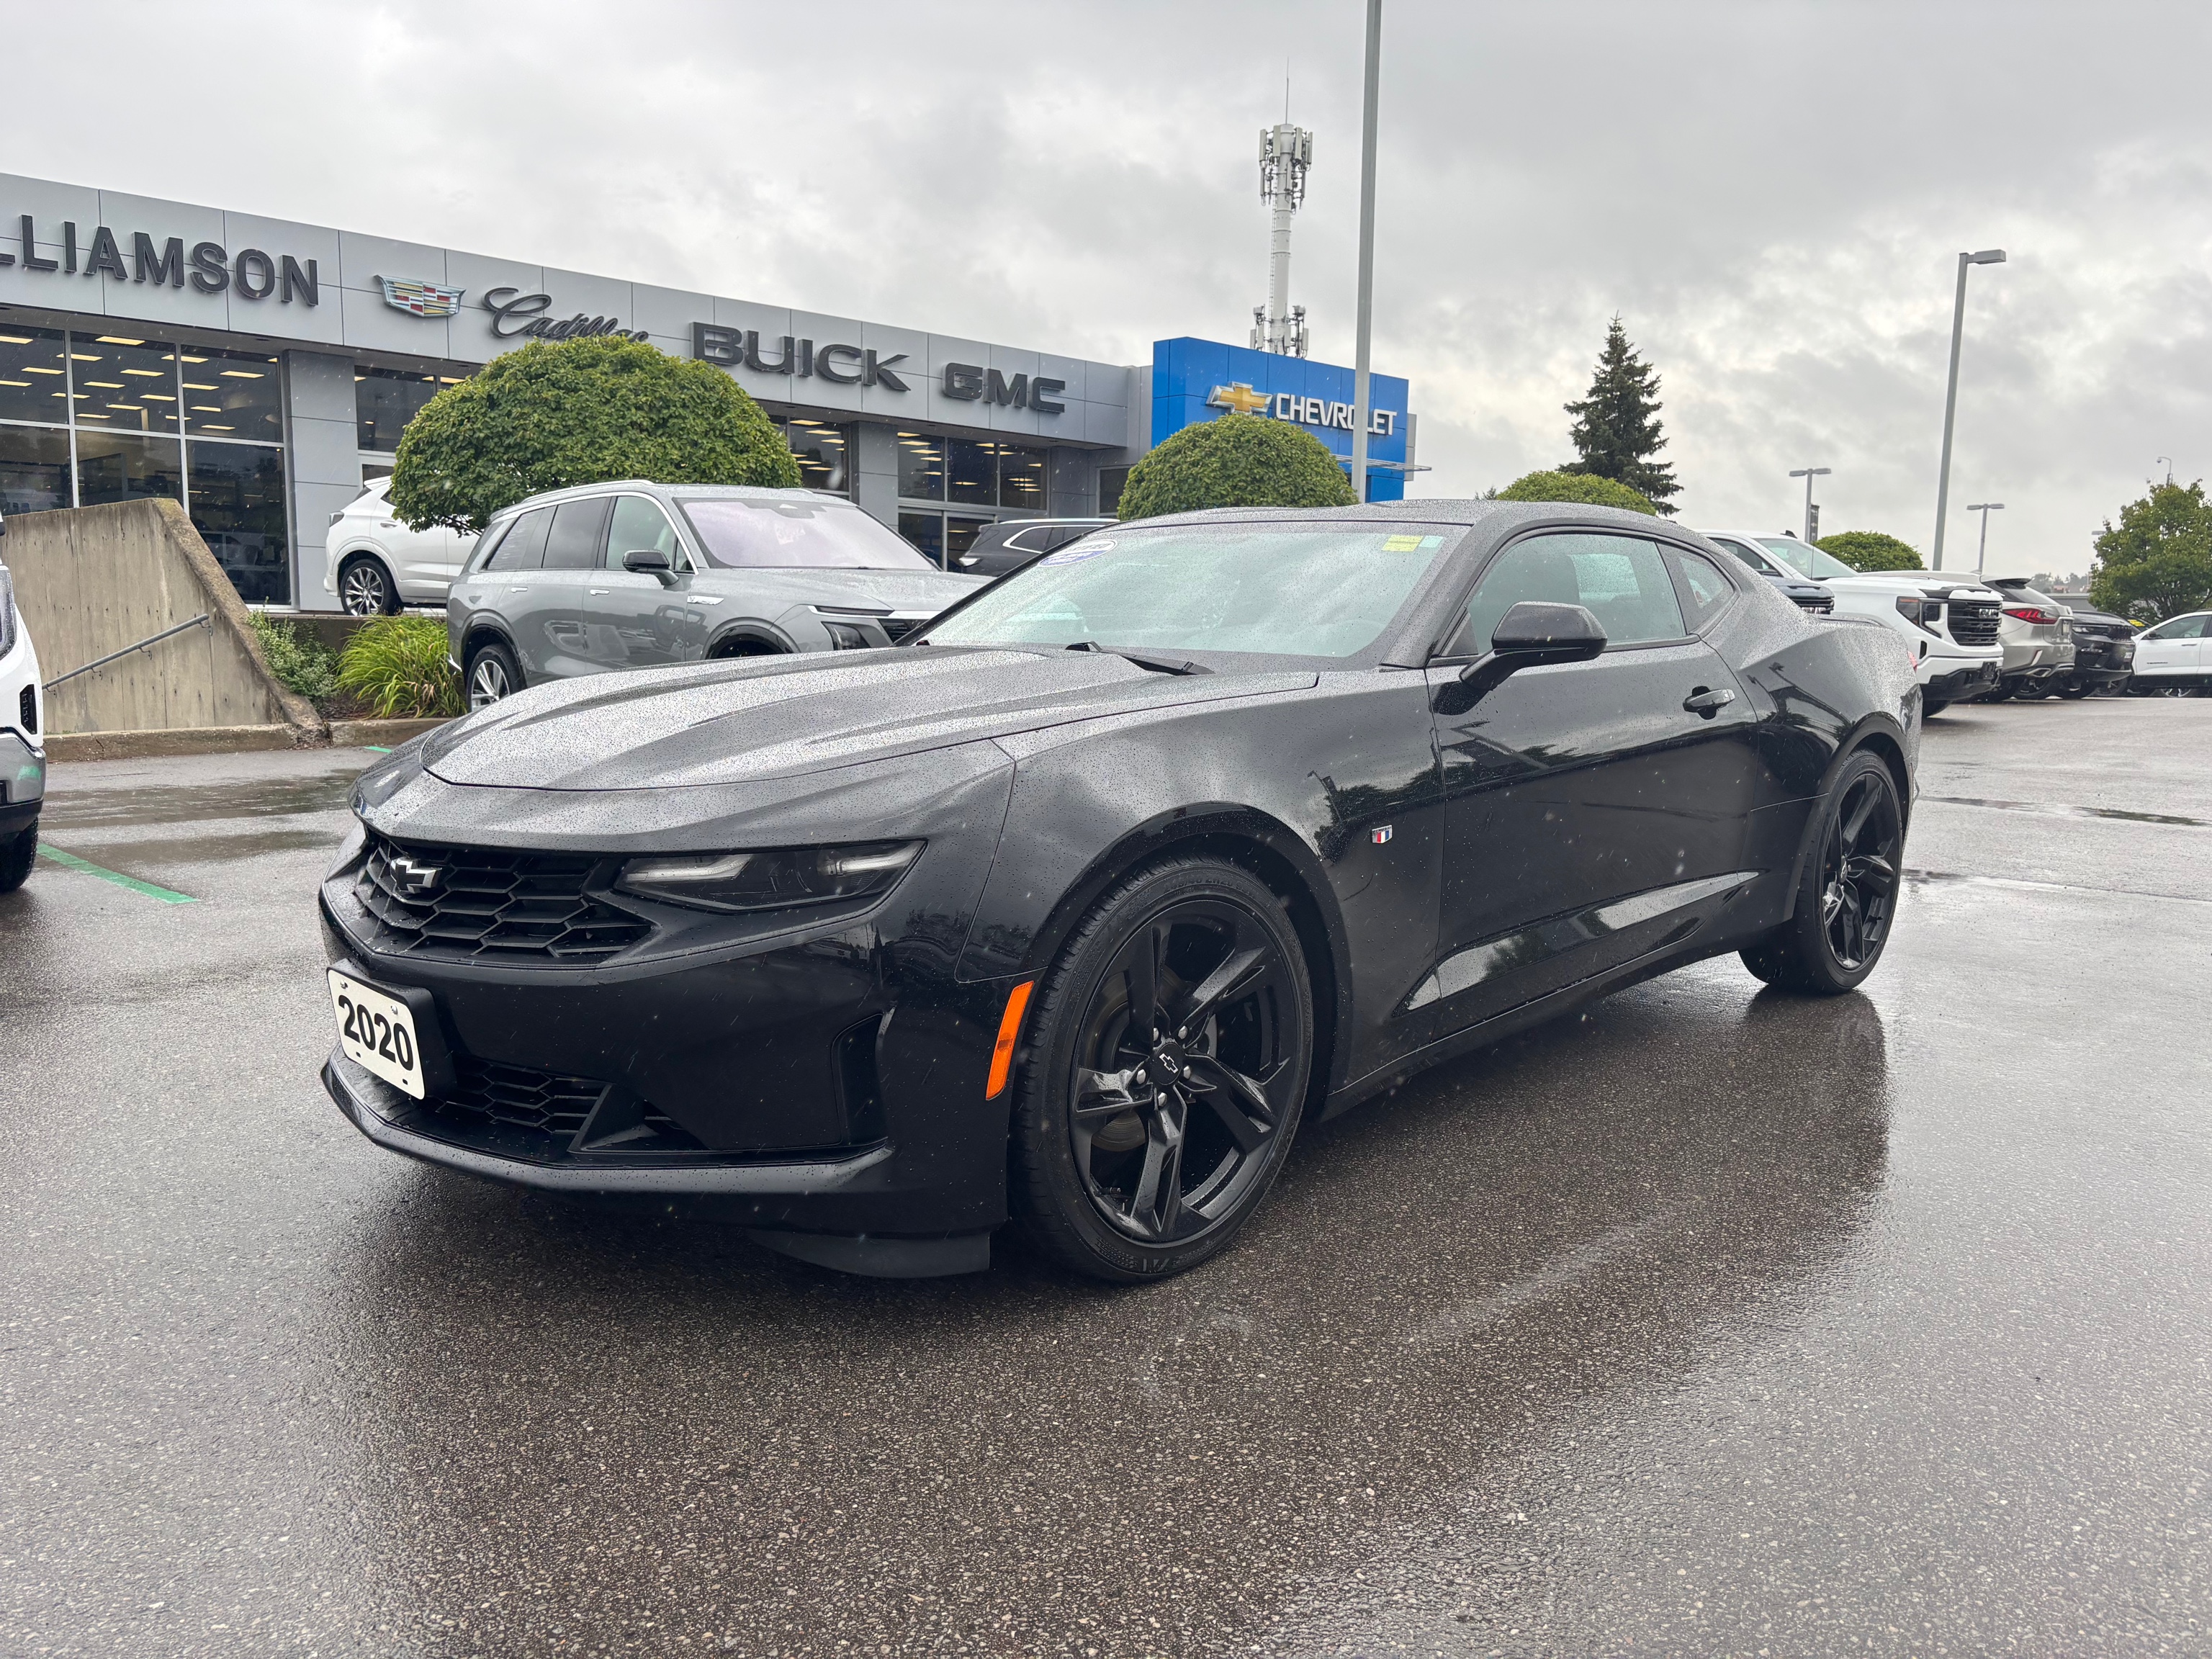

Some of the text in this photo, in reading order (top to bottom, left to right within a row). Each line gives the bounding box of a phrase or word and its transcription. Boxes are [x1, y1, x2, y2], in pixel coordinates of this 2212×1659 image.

[689, 321, 912, 391] BUICK
[942, 361, 1066, 413] GMC
[338, 994, 414, 1071] 2020
